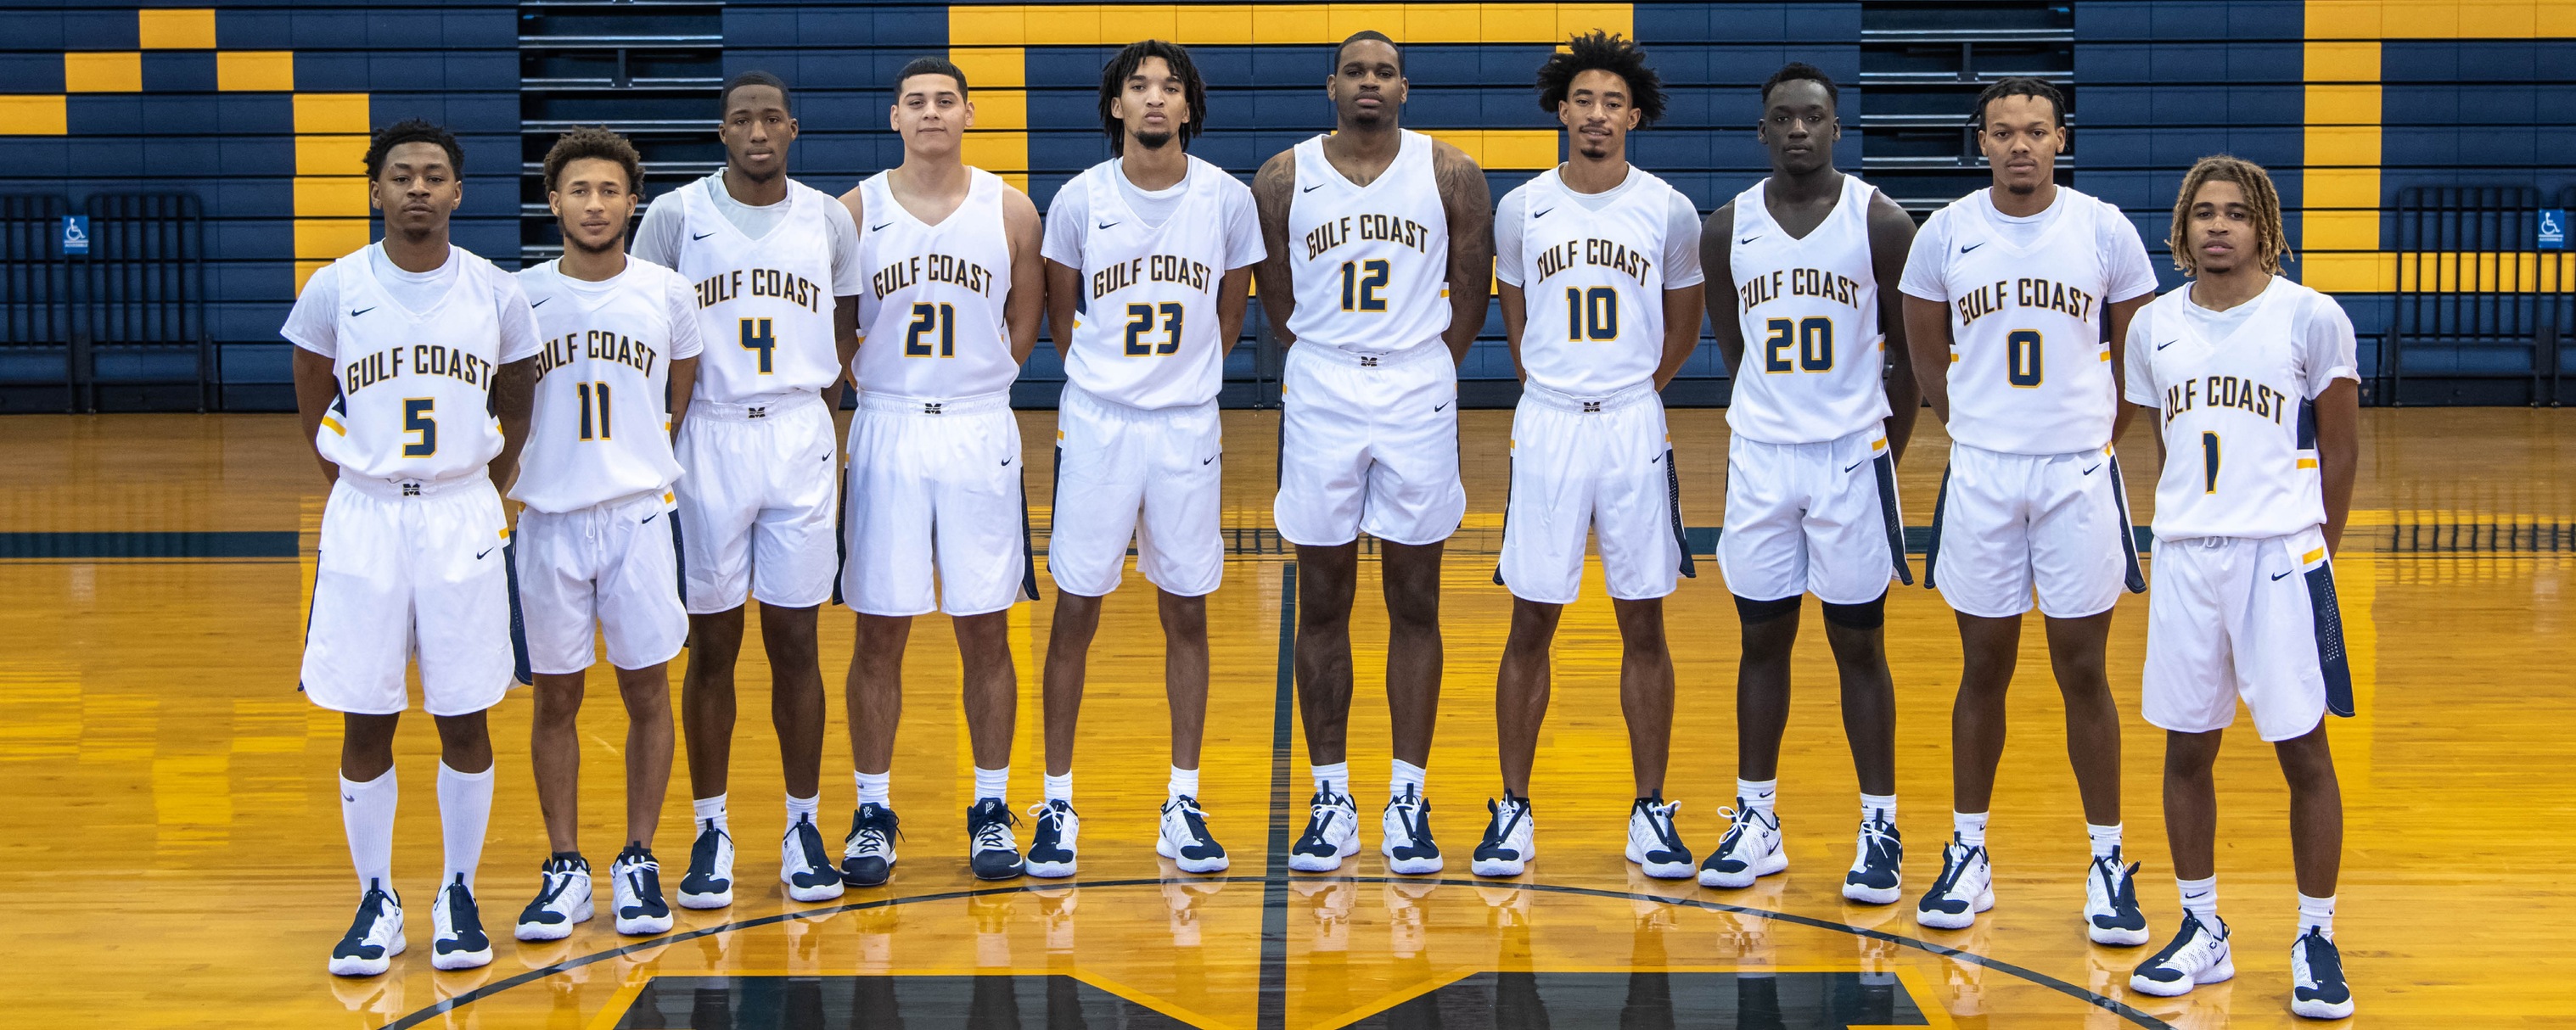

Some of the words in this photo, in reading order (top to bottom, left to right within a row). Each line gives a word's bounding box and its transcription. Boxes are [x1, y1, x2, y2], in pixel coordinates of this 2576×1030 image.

[1305, 216, 1351, 262] GULF
[1360, 214, 1428, 254] COAST
[1586, 238, 1651, 292] COAST
[752, 268, 821, 313] COAST
[873, 256, 920, 301] GULF
[929, 254, 992, 299] COAST
[1093, 257, 1142, 300] GULF
[1151, 255, 1211, 294] COAST
[1340, 258, 1391, 313] 12
[1792, 268, 1859, 310] COAST
[1957, 280, 2007, 327] GULF
[2018, 277, 2093, 323] COAST
[904, 301, 956, 359] 21
[1123, 301, 1184, 357] 23
[1565, 286, 1619, 343] 10
[347, 346, 403, 395] GULF
[413, 344, 492, 393] COAST
[587, 330, 657, 378] COAST
[738, 316, 777, 375] 4
[1765, 316, 1834, 374] 20
[2006, 328, 2044, 389] 0
[401, 396, 437, 459] 5
[576, 381, 612, 442] 11
[2164, 378, 2197, 429] ULF
[2207, 376, 2286, 425] COAST
[2200, 430, 2221, 495] 1
